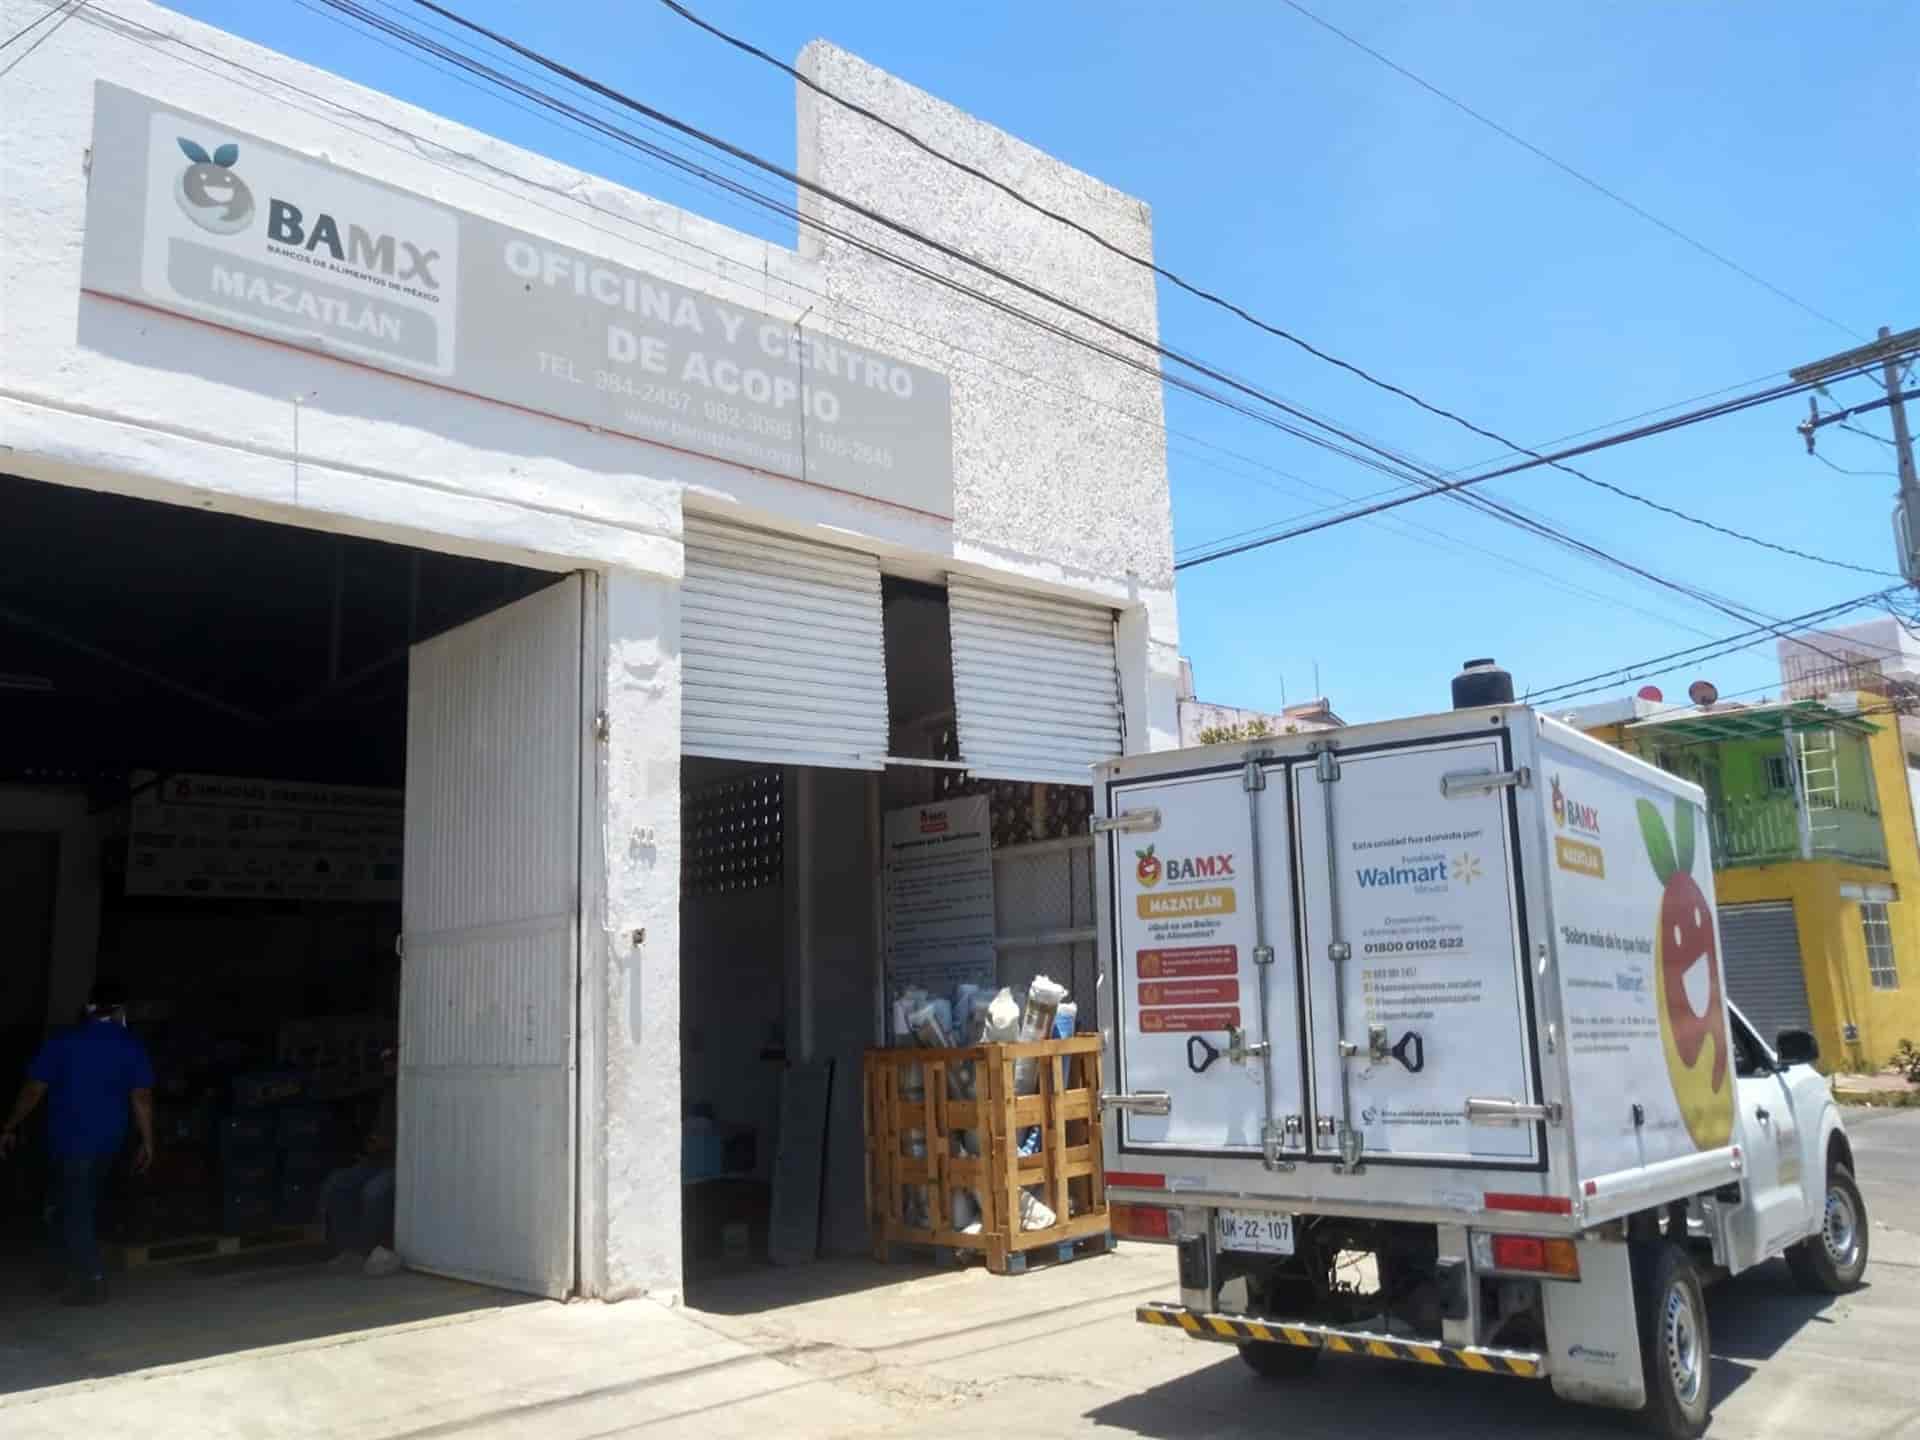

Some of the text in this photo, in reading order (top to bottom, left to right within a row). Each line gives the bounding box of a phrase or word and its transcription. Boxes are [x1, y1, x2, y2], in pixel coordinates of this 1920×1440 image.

[267, 197, 440, 290] BAMX
[266, 244, 311, 265] BANCOS
[312, 257, 328, 271] DE
[328, 263, 387, 290] ALIMENTOS
[387, 280, 402, 293] DE
[503, 239, 913, 400] OFICINA Y CENTRO
[607, 326, 841, 424] DE ACOPIO
[1566, 799, 1600, 834] BAMX
[1352, 840, 1373, 851] Esta
[1374, 837, 1407, 849] unidad
[1425, 831, 1462, 843] donada
[1166, 854, 1234, 880] BAMX
[1356, 860, 1448, 889] Walmart
[1150, 893, 1223, 913] MAZATLÁN
[1364, 937, 1464, 955] 01800 0102 622
